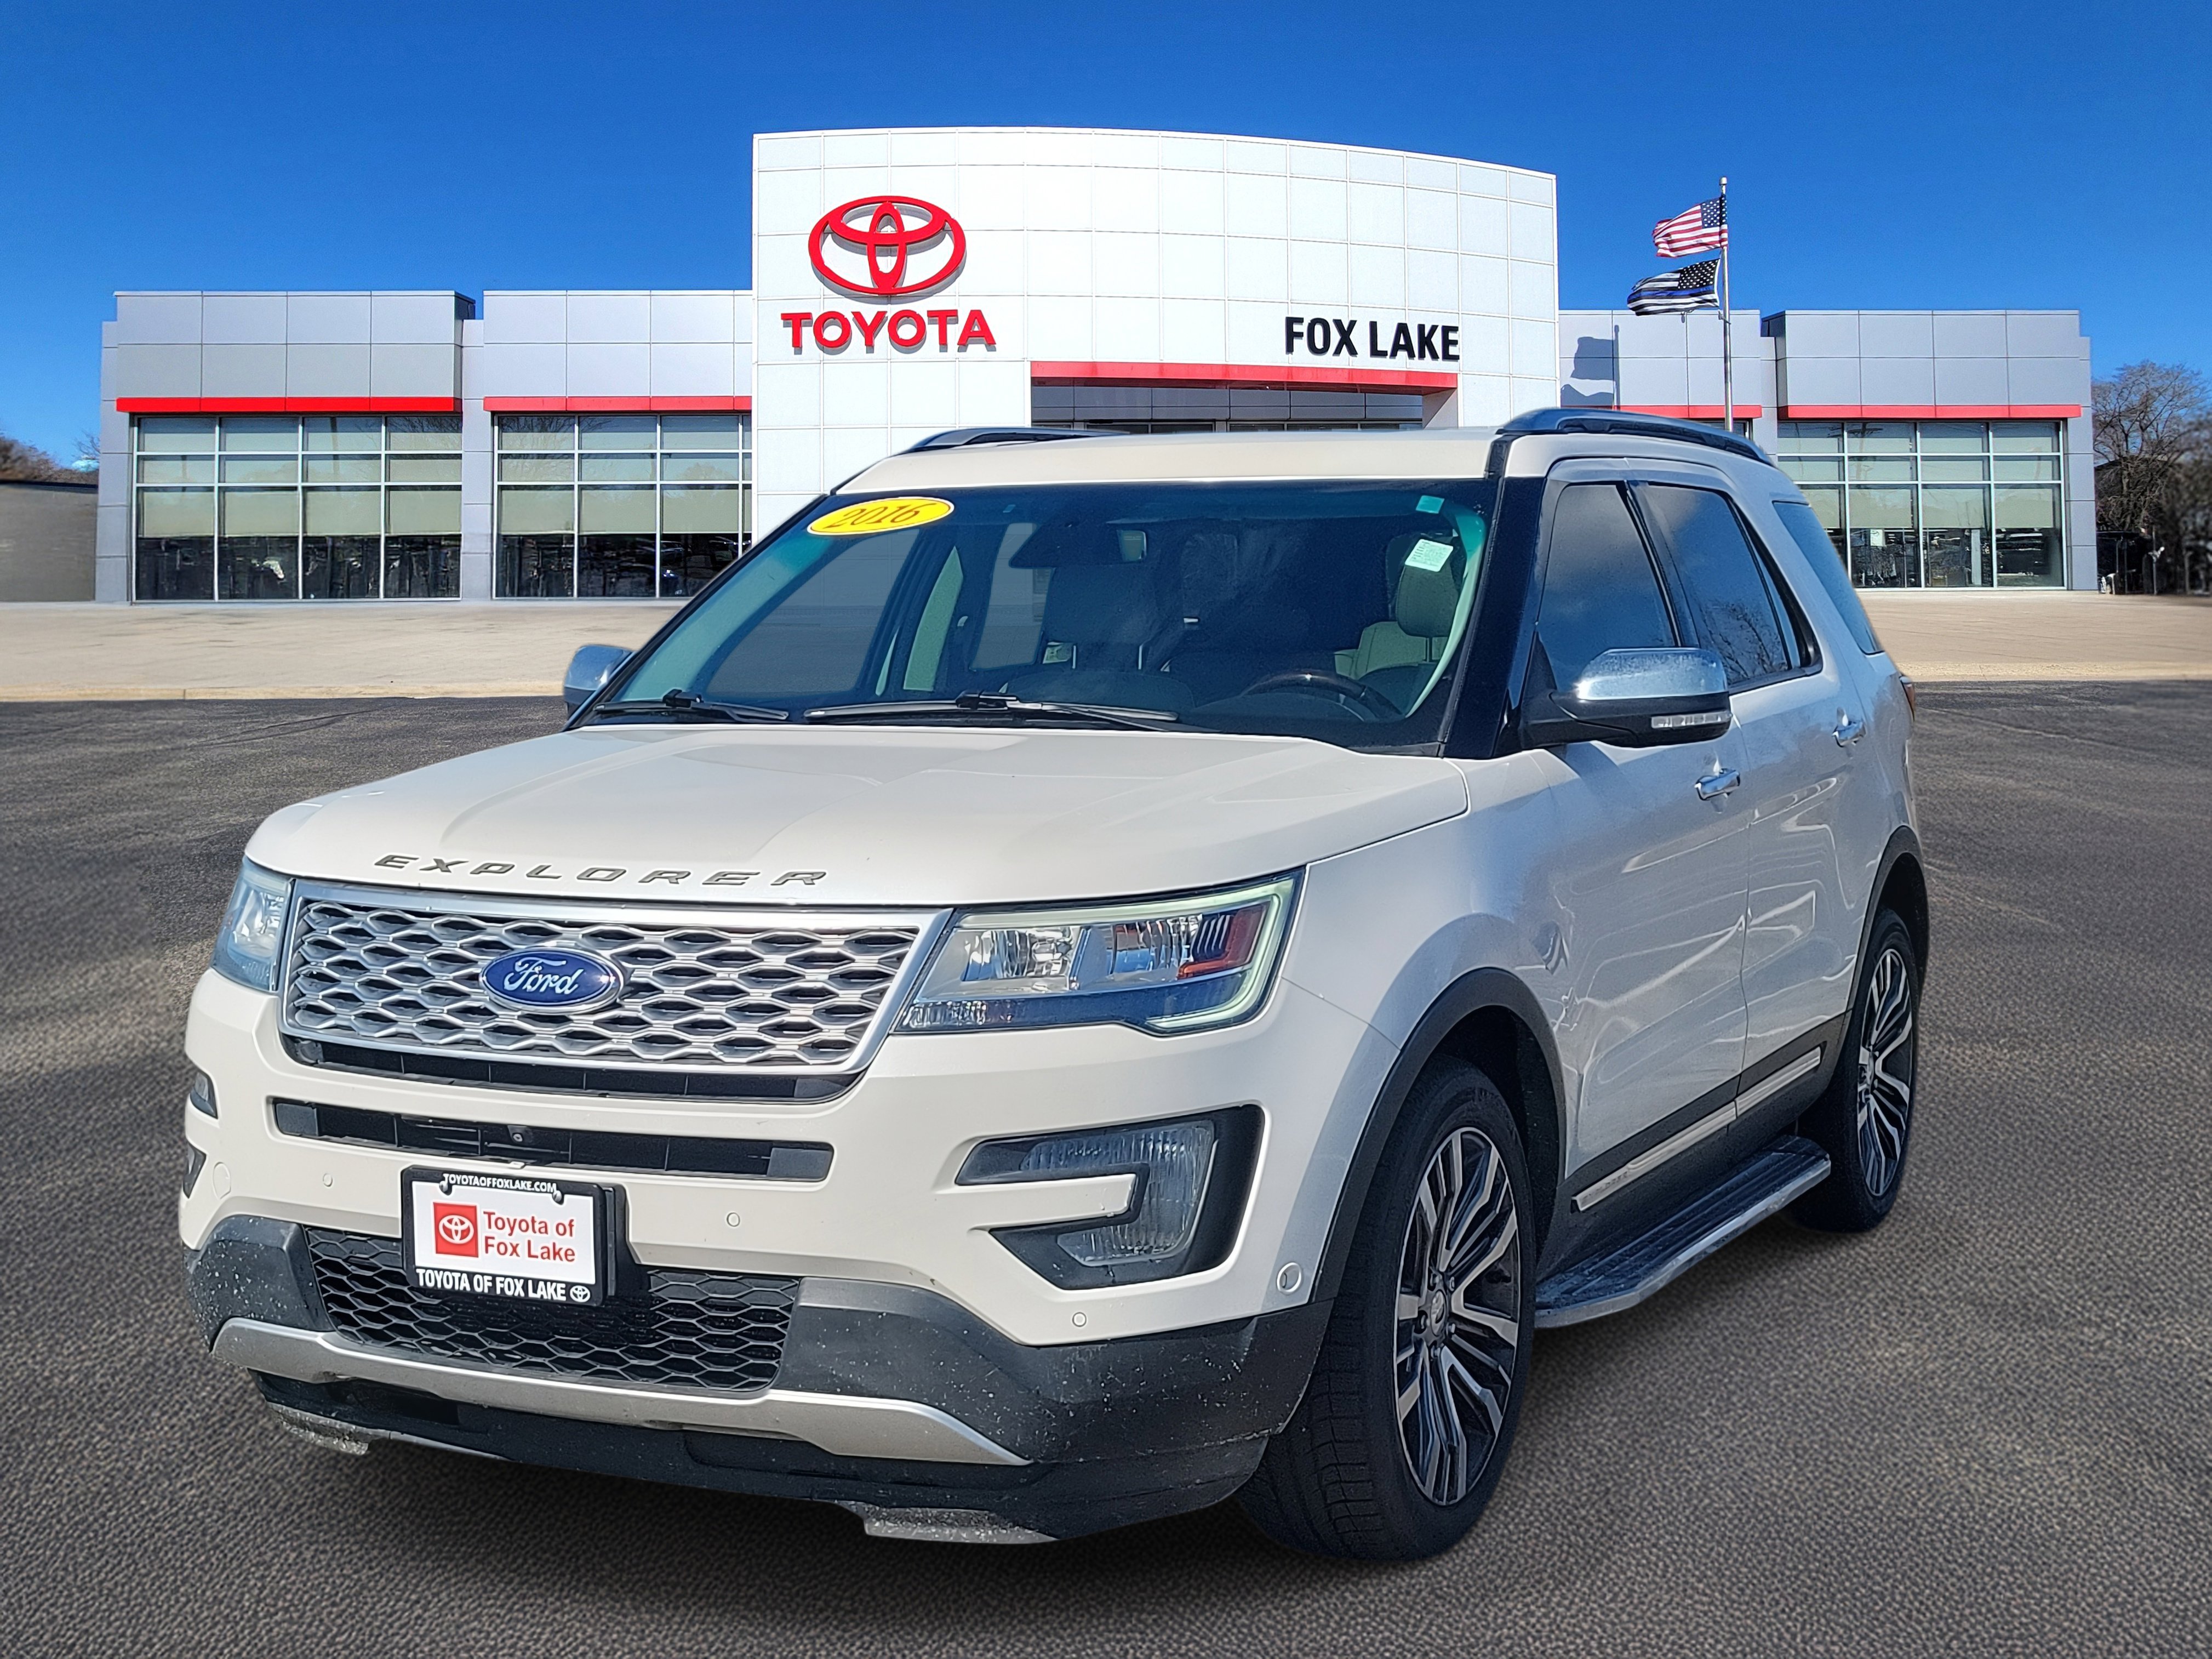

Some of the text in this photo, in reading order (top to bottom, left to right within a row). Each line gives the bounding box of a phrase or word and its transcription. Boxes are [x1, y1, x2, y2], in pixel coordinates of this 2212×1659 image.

[781, 309, 996, 351] TOYOTA
[1285, 317, 1460, 361] FOX LAKE
[823, 503, 937, 529] 2016
[374, 854, 827, 886] EXPLORER
[504, 956, 584, 995] Ford
[443, 1173, 557, 1193] TOYOTAOFFOXLAKE.COM
[483, 1211, 575, 1237] Toyota of
[484, 1236, 575, 1262] Fox Lake
[416, 1268, 567, 1301] TOYOTA OF FOX LAKE
